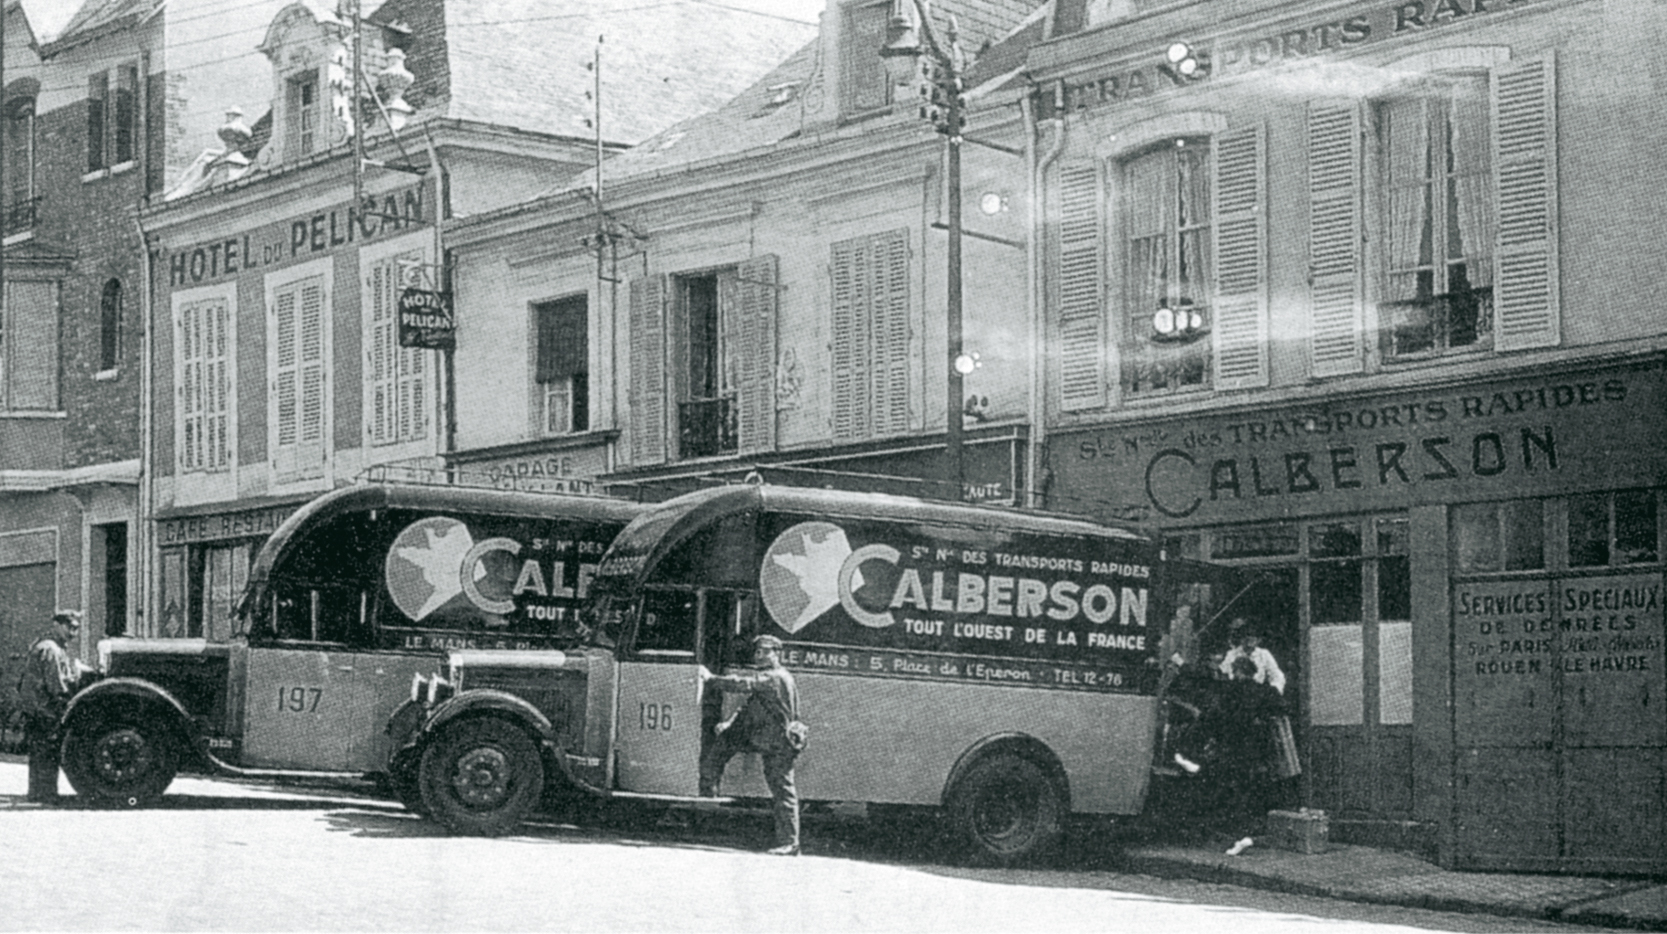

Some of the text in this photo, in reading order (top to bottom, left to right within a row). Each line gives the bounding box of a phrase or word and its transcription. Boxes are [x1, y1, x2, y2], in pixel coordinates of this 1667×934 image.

[1226, 401, 1448, 444] TRANSPORTS
[1460, 379, 1627, 418] RAPIDES
[1145, 425, 1558, 519] CALBERSON
[962, 550, 987, 564] DES
[995, 553, 1083, 572] TRANSPORTS
[1091, 560, 1150, 578] RAPIDES
[838, 543, 1149, 628] CALBERSON
[527, 605, 566, 620] TOUT
[1459, 592, 1545, 615] SERVICES
[405, 636, 423, 649] LE
[431, 637, 476, 650] MANS
[904, 618, 1146, 651] TOUT L'OUEST DE LA FRANCE
[1499, 638, 1551, 654] PARIS
[780, 650, 798, 664] LE
[893, 657, 931, 674] Place
[940, 661, 958, 675] de
[1476, 655, 1649, 675] ROUEN LE HAVRE
[279, 686, 322, 712] 197
[640, 702, 673, 731] 196
